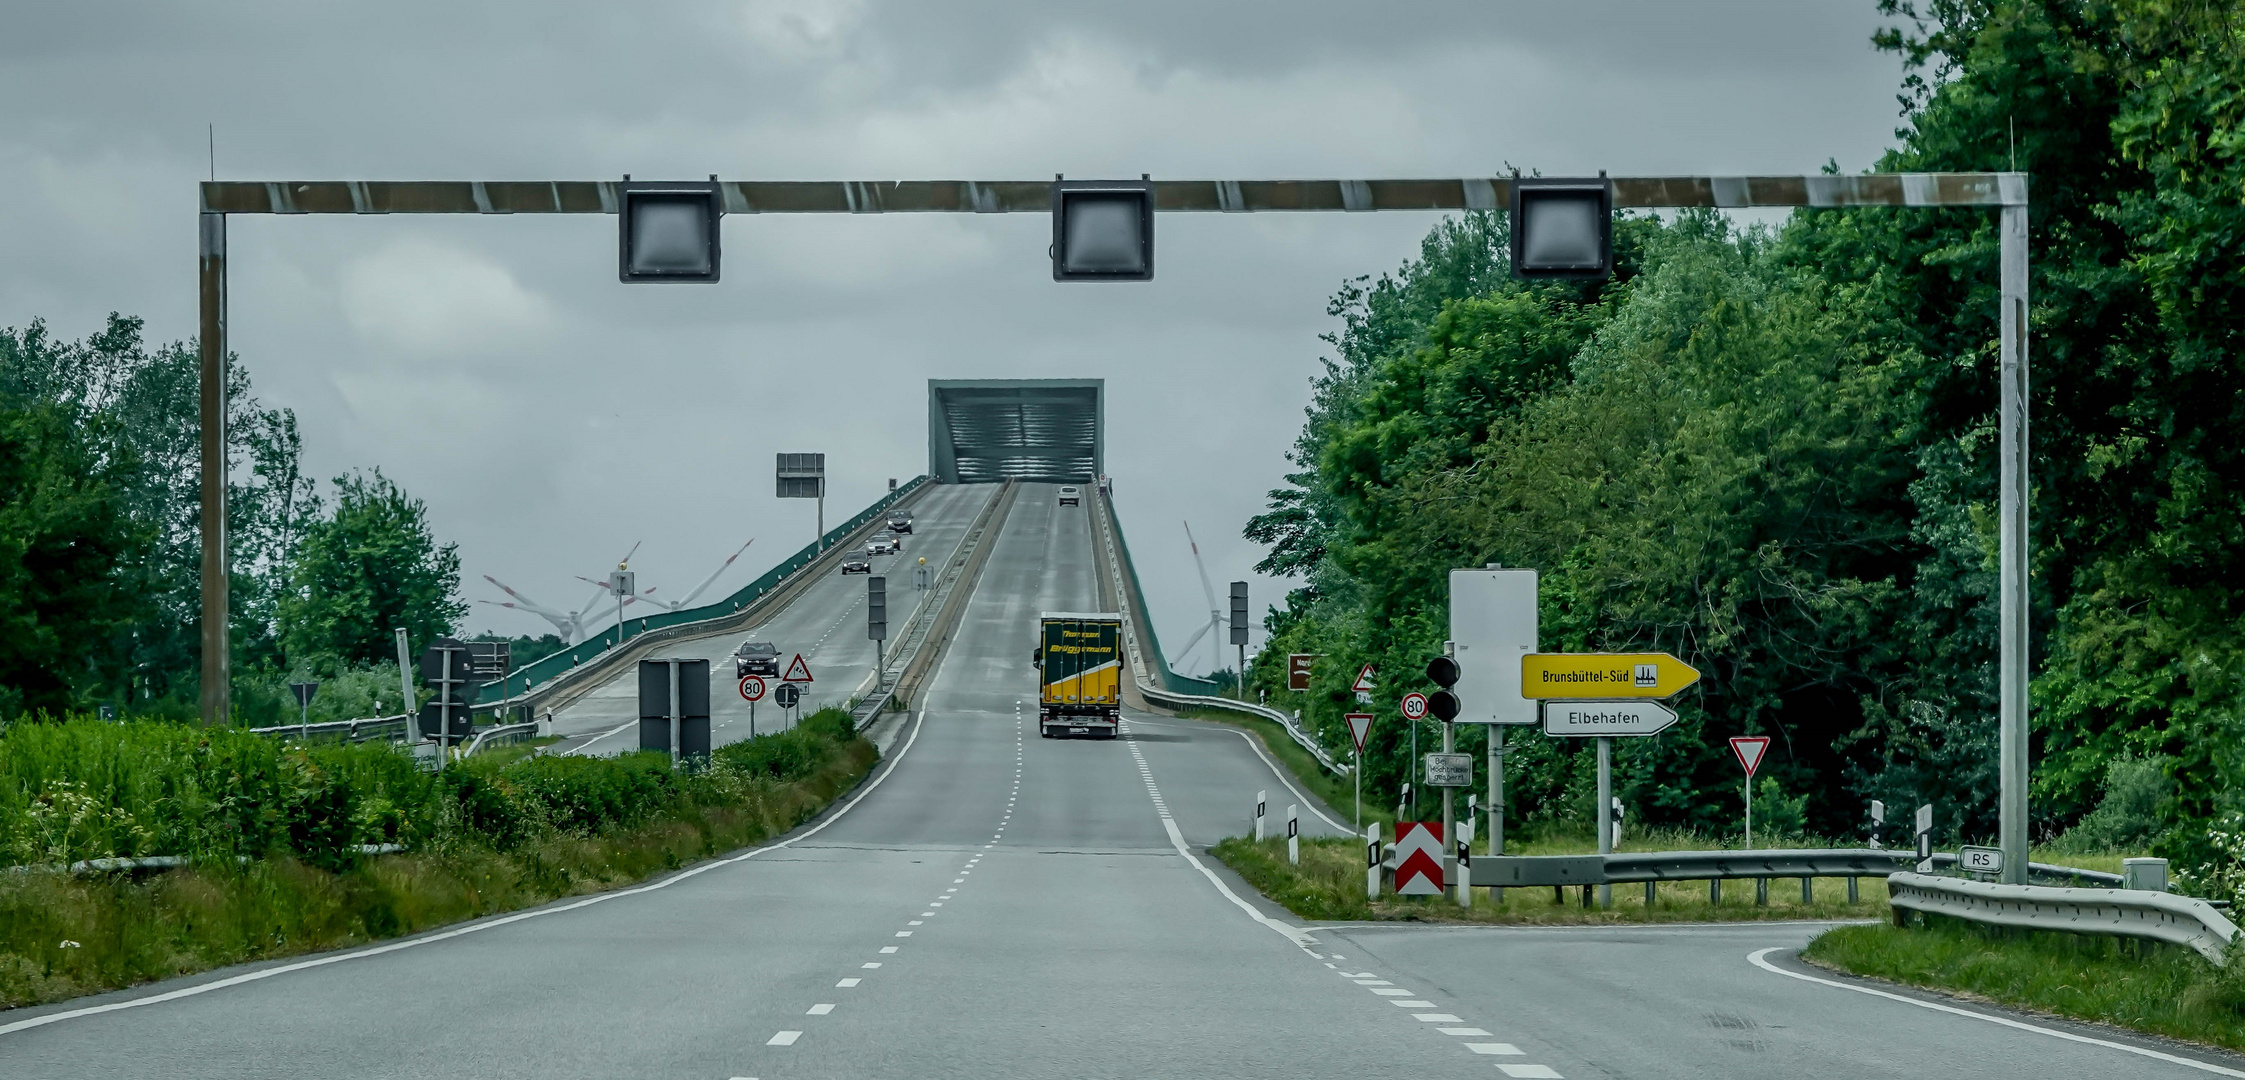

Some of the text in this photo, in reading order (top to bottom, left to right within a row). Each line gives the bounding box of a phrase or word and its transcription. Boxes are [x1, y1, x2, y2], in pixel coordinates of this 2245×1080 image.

[1543, 670, 1629, 683] Brunsbüttel-Süd
[745, 682, 760, 695] 80
[1407, 700, 1423, 713] 80
[1569, 711, 1640, 724] Elbehafen
[1972, 853, 1990, 866] RS
